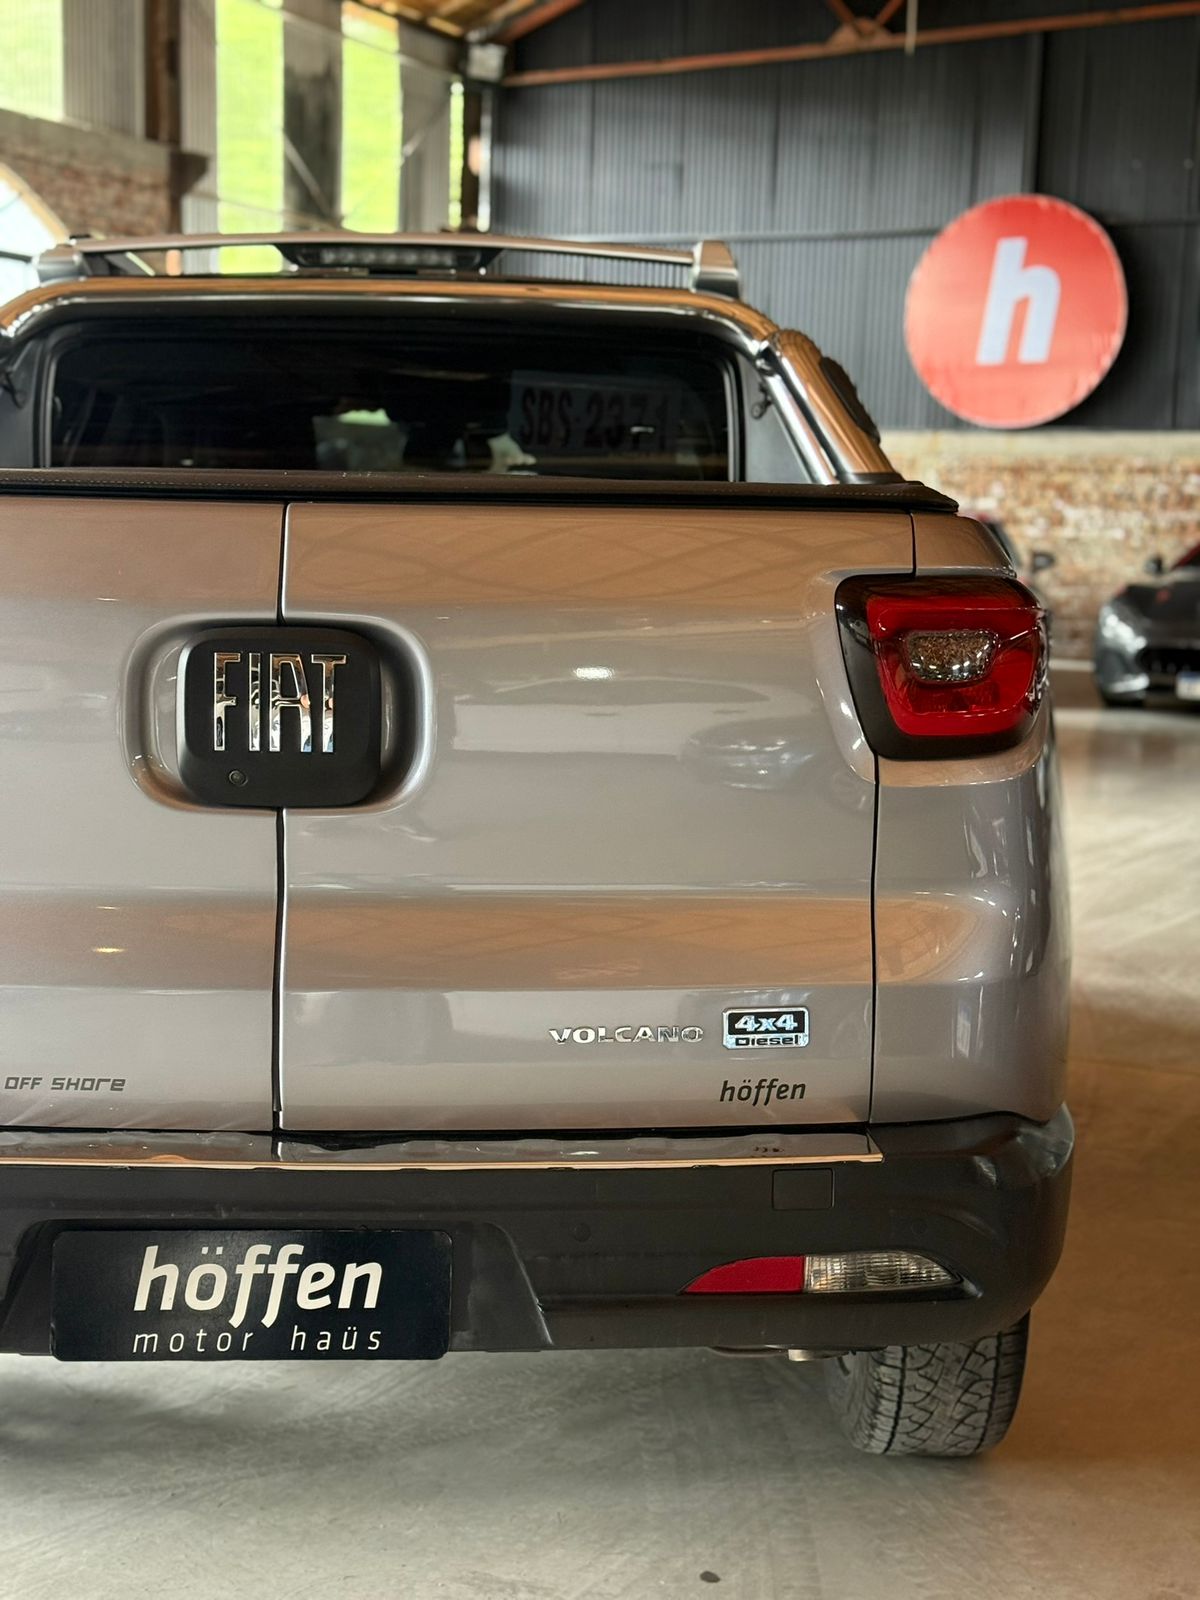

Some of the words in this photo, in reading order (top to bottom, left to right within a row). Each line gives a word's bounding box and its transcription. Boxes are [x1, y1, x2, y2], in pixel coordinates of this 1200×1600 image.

[976, 236, 1061, 365] h
[213, 651, 347, 753] FIAT
[549, 1026, 704, 1045] VOLCANO
[734, 1013, 798, 1032] 4x4
[734, 1034, 801, 1047] Diesel
[4, 1076, 43, 1090] OFF
[719, 1078, 807, 1107] höffen
[133, 1243, 383, 1329] höffen
[132, 1329, 254, 1354] motor
[290, 1324, 382, 1352] haüs
